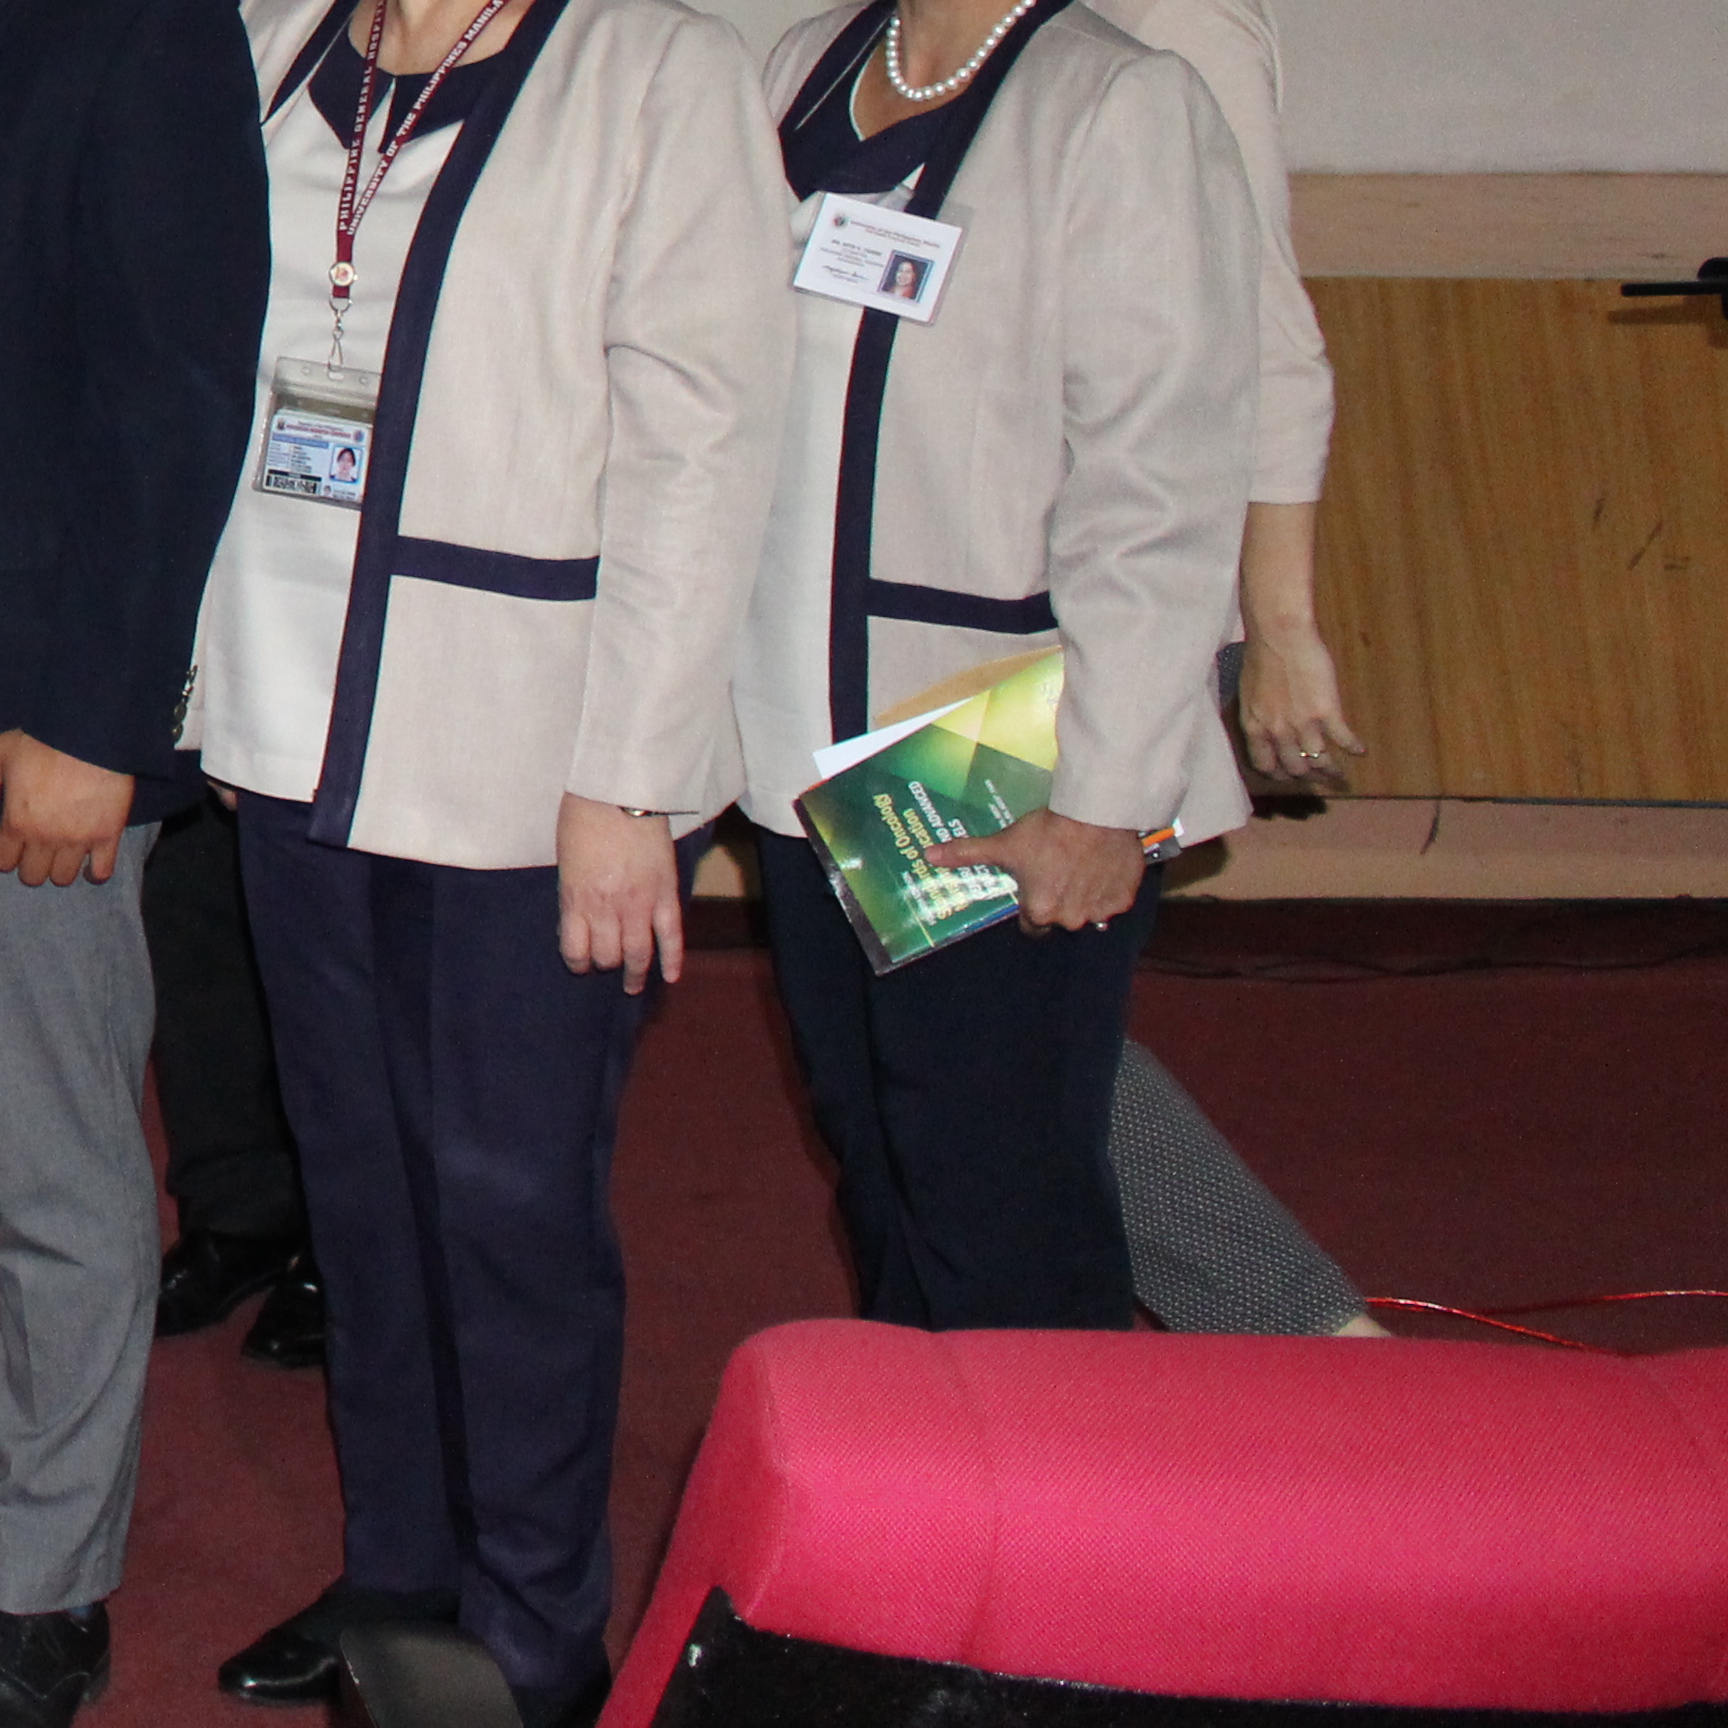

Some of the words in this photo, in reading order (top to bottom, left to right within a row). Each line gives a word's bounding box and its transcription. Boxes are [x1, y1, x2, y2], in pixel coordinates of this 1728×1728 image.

[339, 139, 361, 231] PHILIPPINE
[354, 66, 373, 133] GENERAL
[346, 159, 388, 235] UNIVERSITY
[386, 139, 400, 158] OF
[395, 112, 416, 137] THE
[413, 41, 468, 110] PHILIPPINES
[872, 792, 911, 849] Oncology
[908, 780, 944, 828] ADVANCED
[899, 845, 919, 861] of
